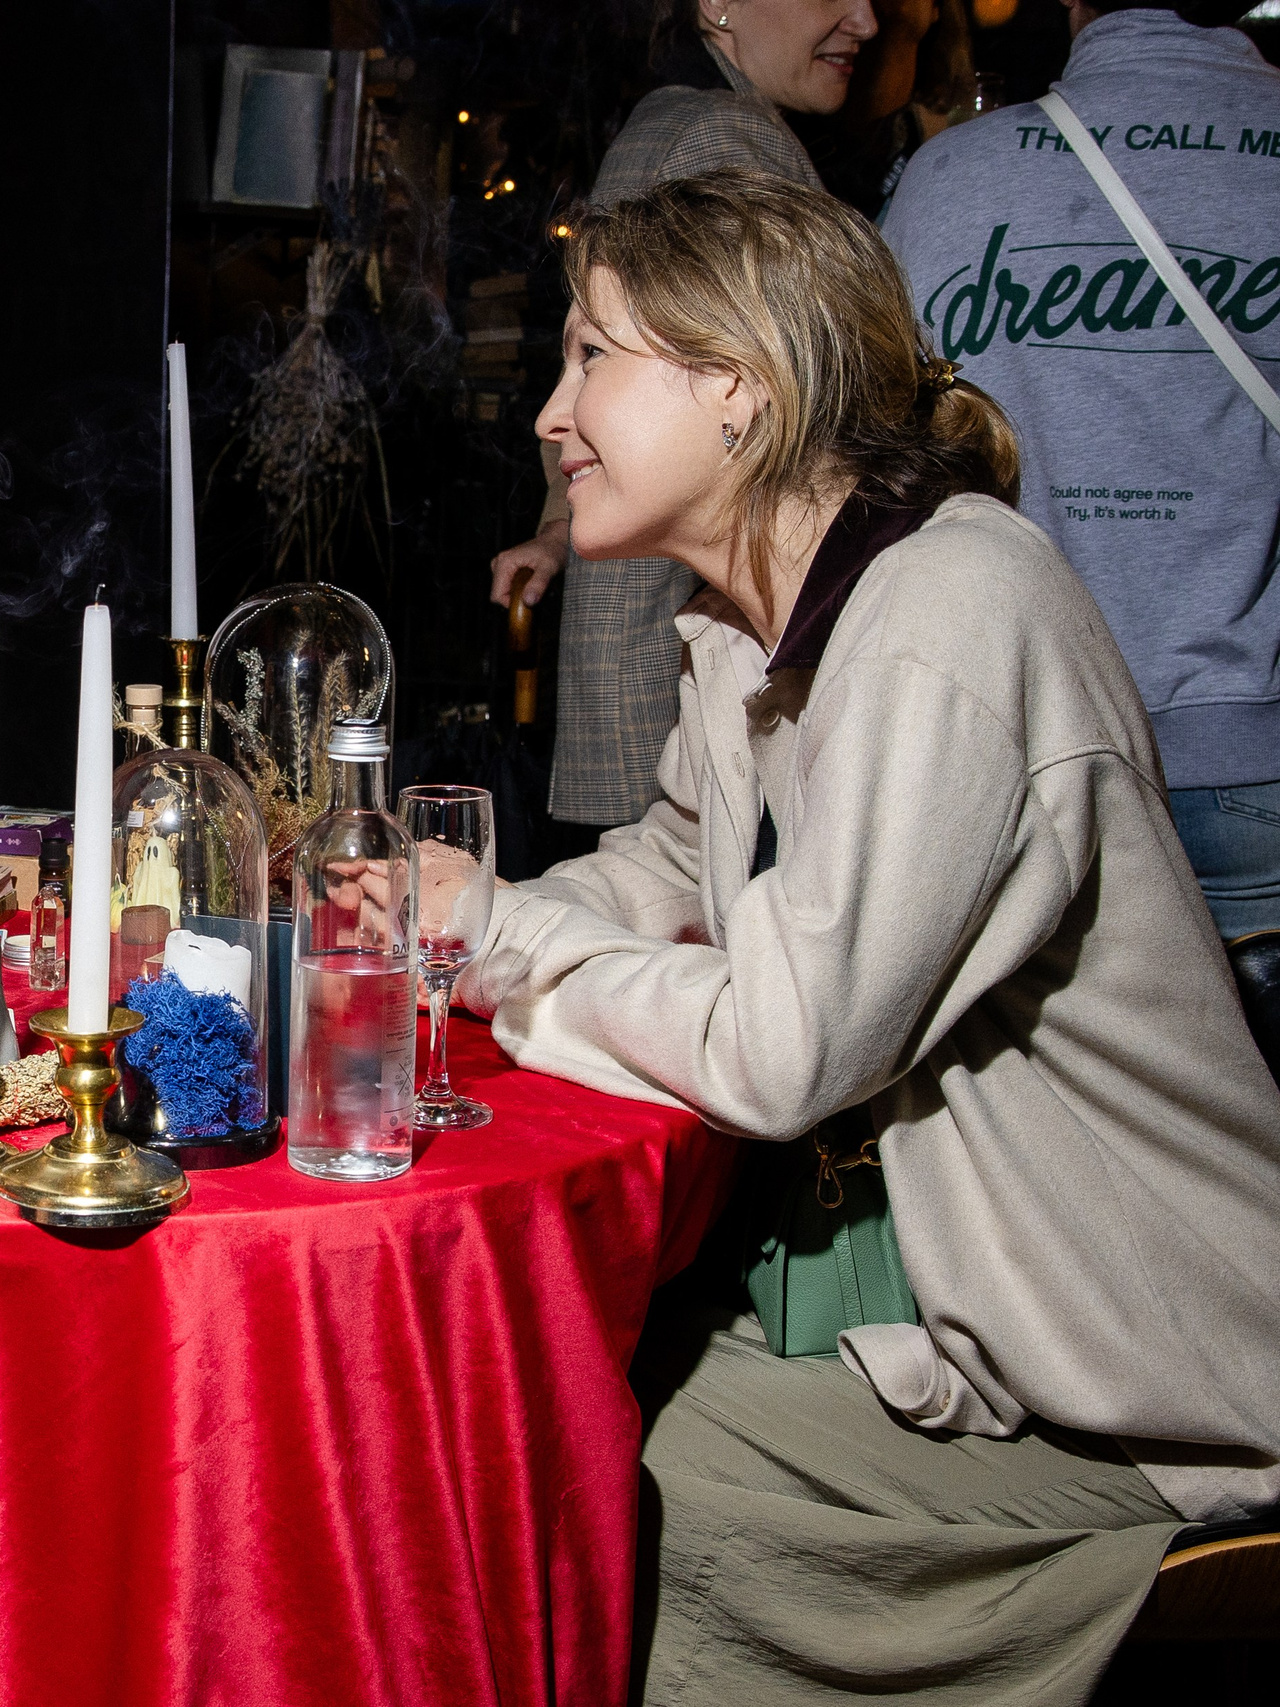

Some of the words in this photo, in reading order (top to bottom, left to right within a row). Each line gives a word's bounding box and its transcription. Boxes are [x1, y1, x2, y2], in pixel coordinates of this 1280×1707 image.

[1016, 125, 1115, 152] THY
[1124, 124, 1226, 151] CALL
[1049, 485, 1081, 499] Could
[1085, 486, 1110, 499] not
[1113, 488, 1153, 503] agree
[1156, 490, 1194, 501] more
[1065, 506, 1091, 521] Try,
[1094, 505, 1116, 518] it's
[1119, 507, 1161, 520] worth
[1164, 508, 1176, 521] it
